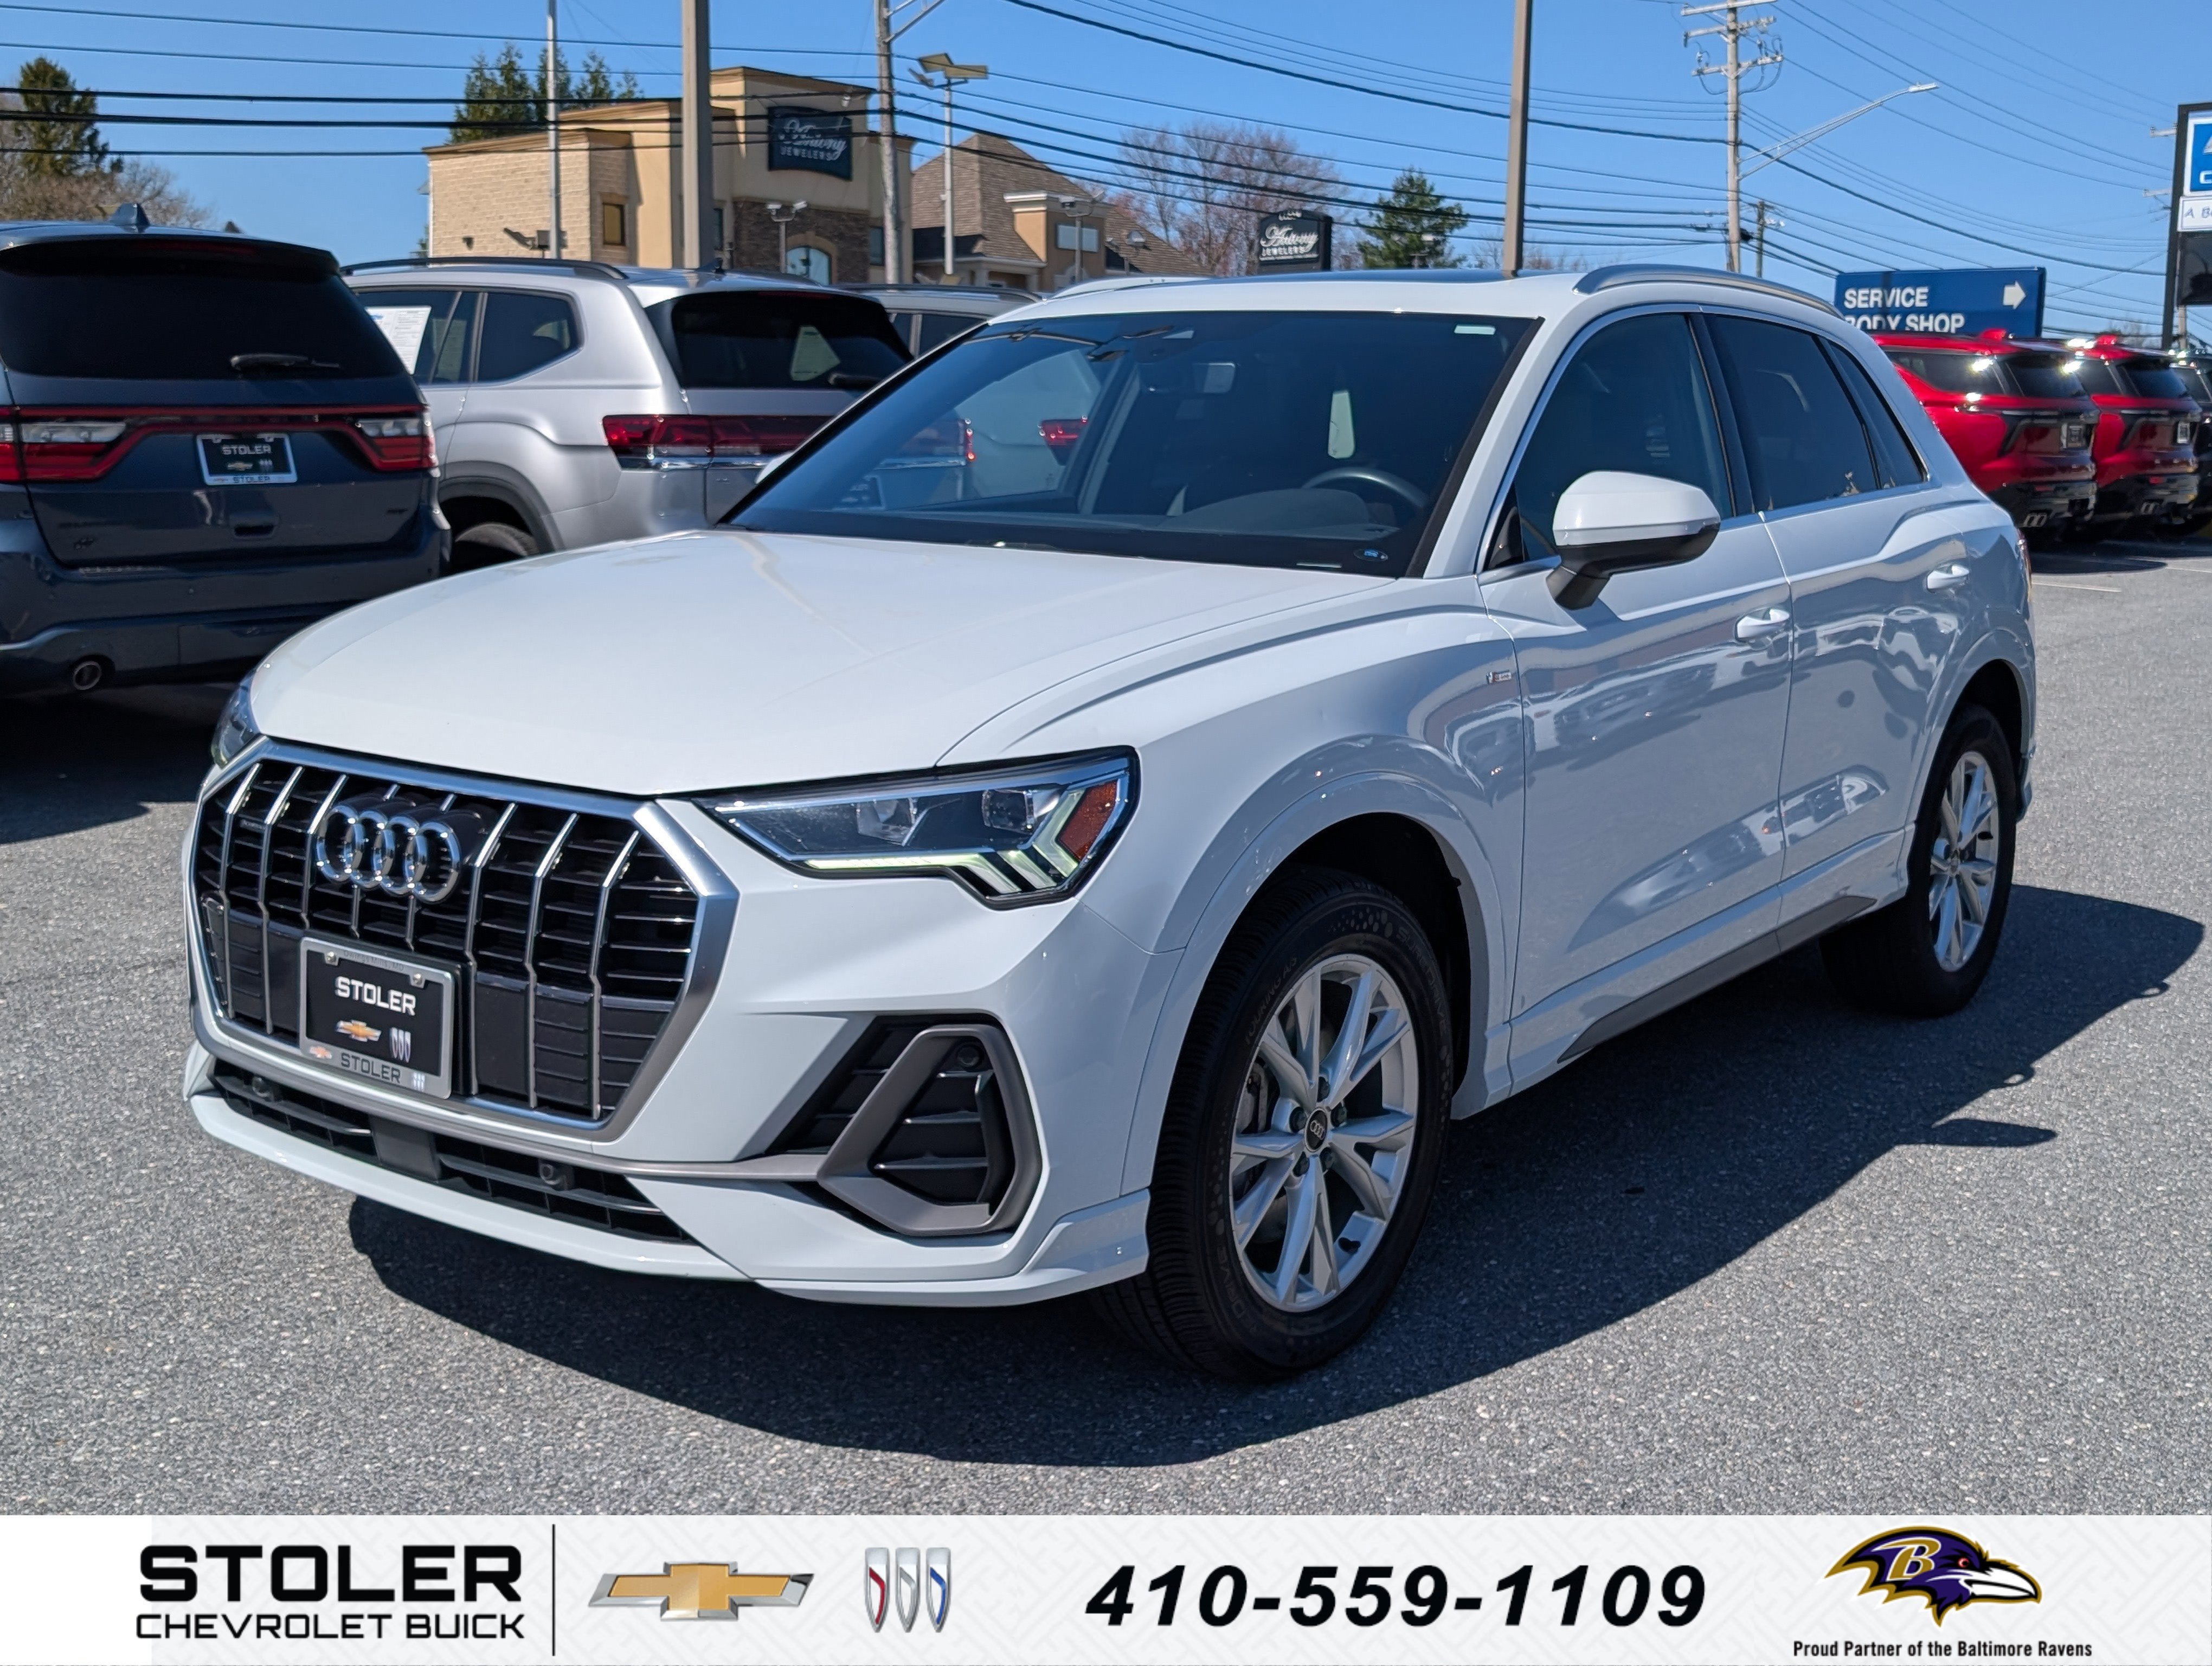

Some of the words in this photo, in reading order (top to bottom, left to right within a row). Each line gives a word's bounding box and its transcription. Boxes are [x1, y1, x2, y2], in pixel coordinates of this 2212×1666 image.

[1843, 286, 1929, 309] SERVICE
[1905, 312, 1965, 334] SHOP
[221, 444, 272, 456] STOLER
[335, 976, 416, 1016] STOLER
[340, 1052, 401, 1084] STOLER
